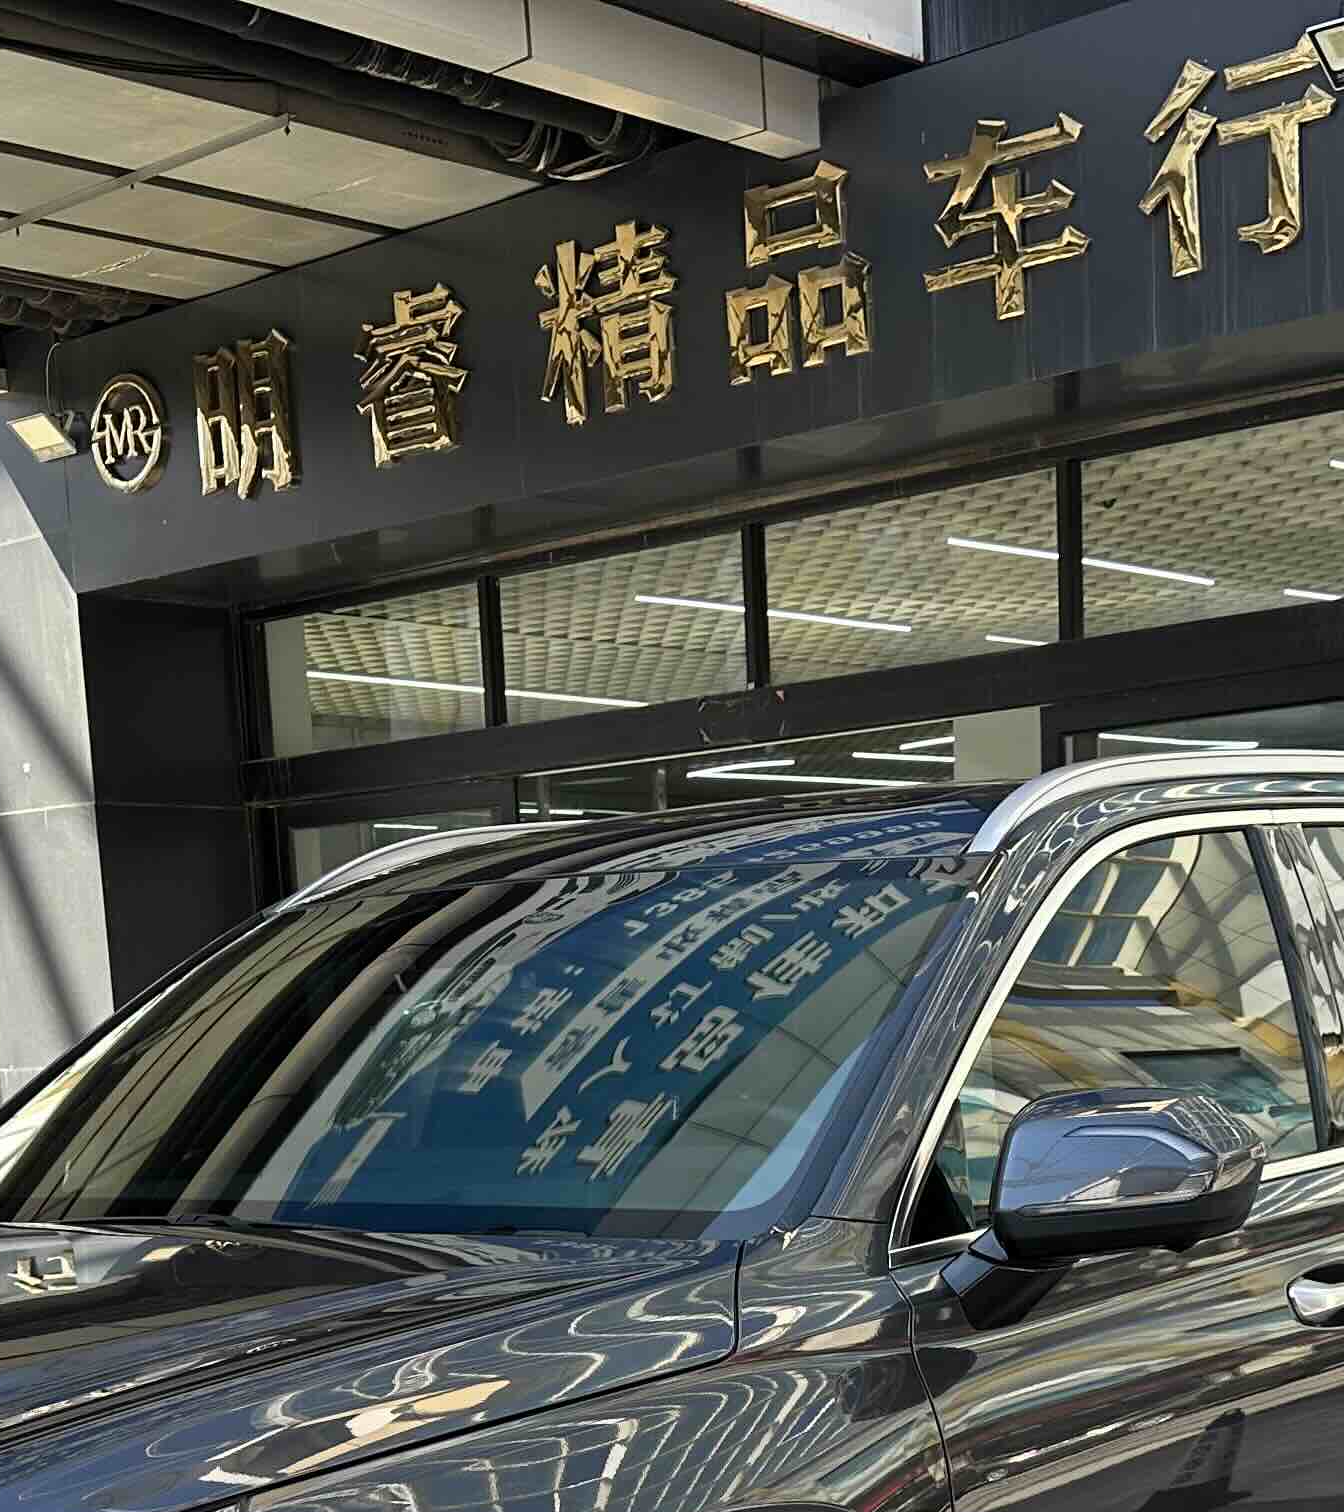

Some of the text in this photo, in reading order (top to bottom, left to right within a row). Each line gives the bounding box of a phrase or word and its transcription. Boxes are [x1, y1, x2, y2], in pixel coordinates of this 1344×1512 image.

[192, 57, 1338, 500] 明睿精品车行
